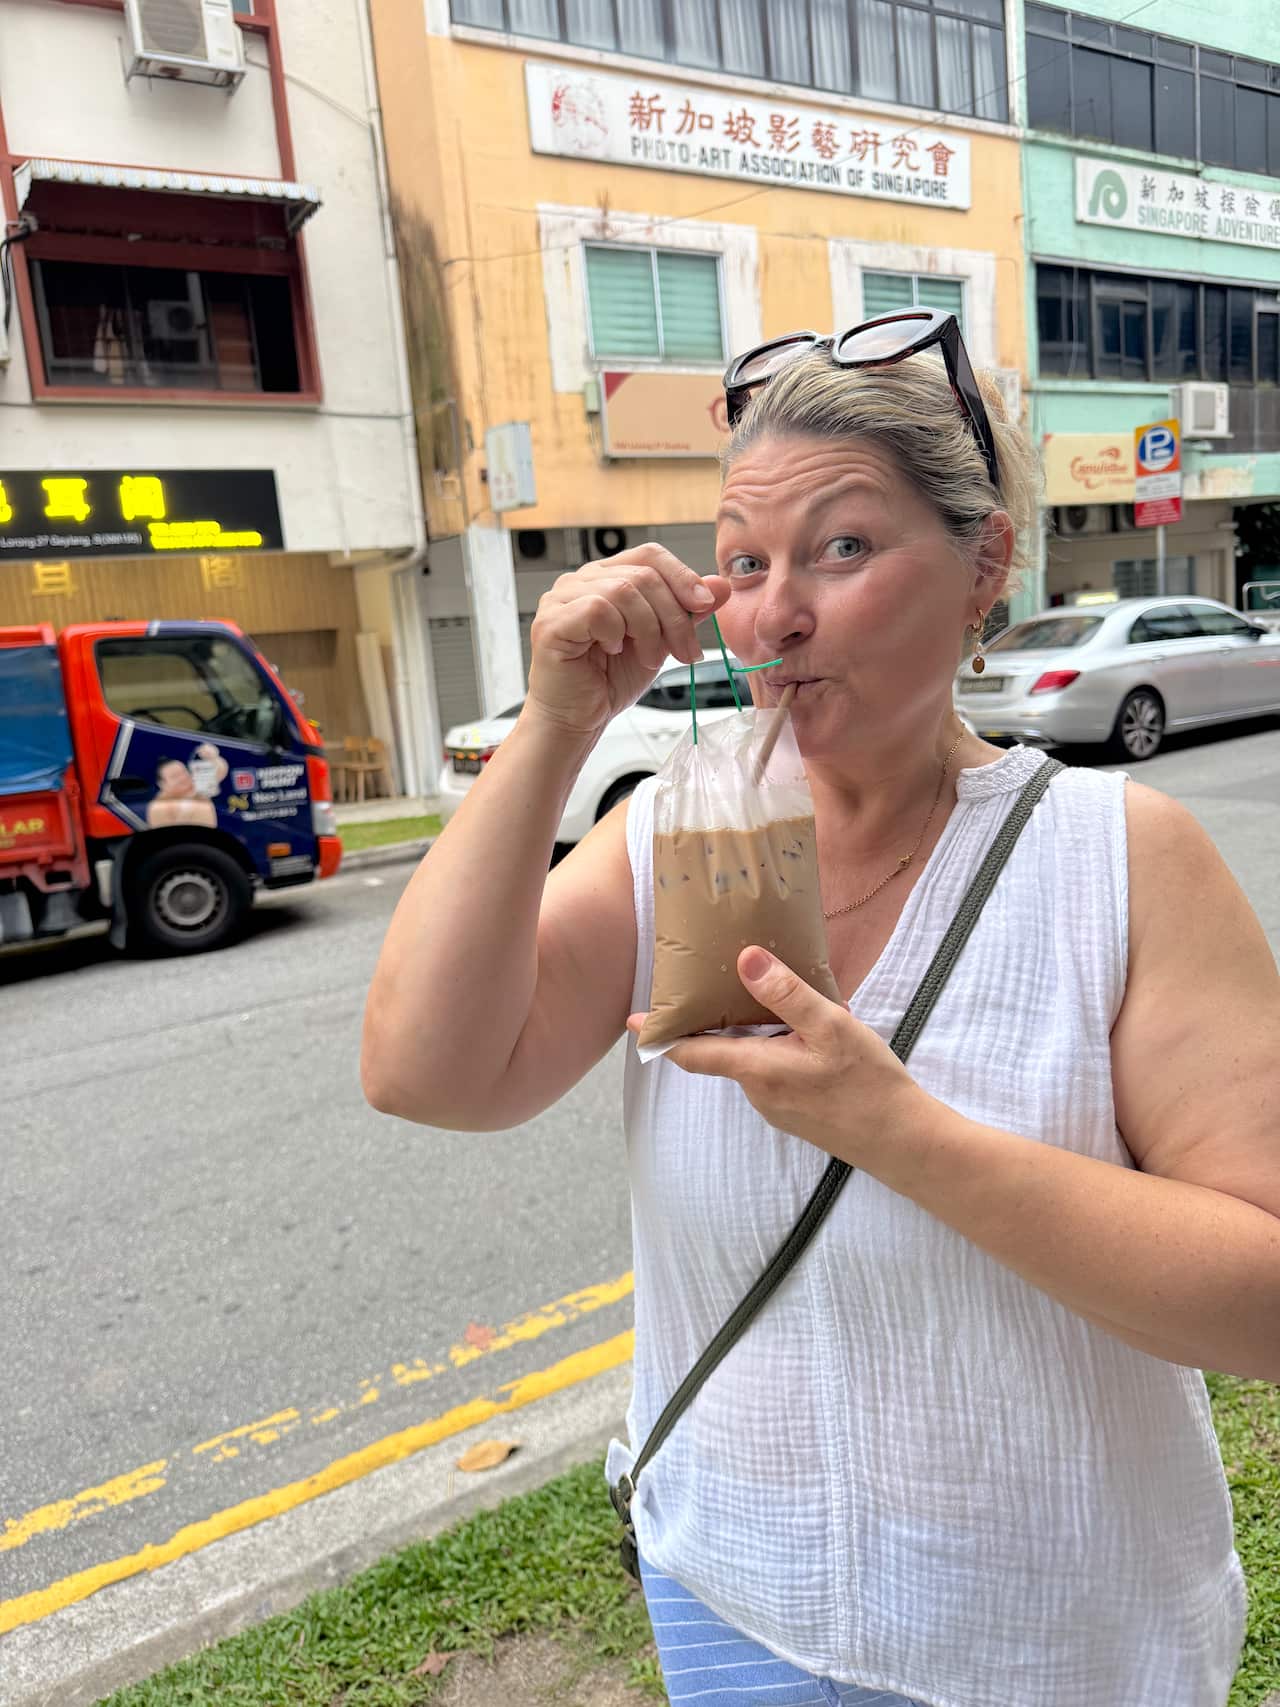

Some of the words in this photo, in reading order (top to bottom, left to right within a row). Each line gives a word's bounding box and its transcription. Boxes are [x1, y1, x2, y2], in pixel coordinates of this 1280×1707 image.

[630, 136, 732, 169] PHOTO-ART
[738, 150, 842, 185] ASSOCIATION
[847, 167, 865, 188] OF
[871, 171, 949, 200] SINGAPORE
[1137, 205, 1208, 233] SINGAPORE
